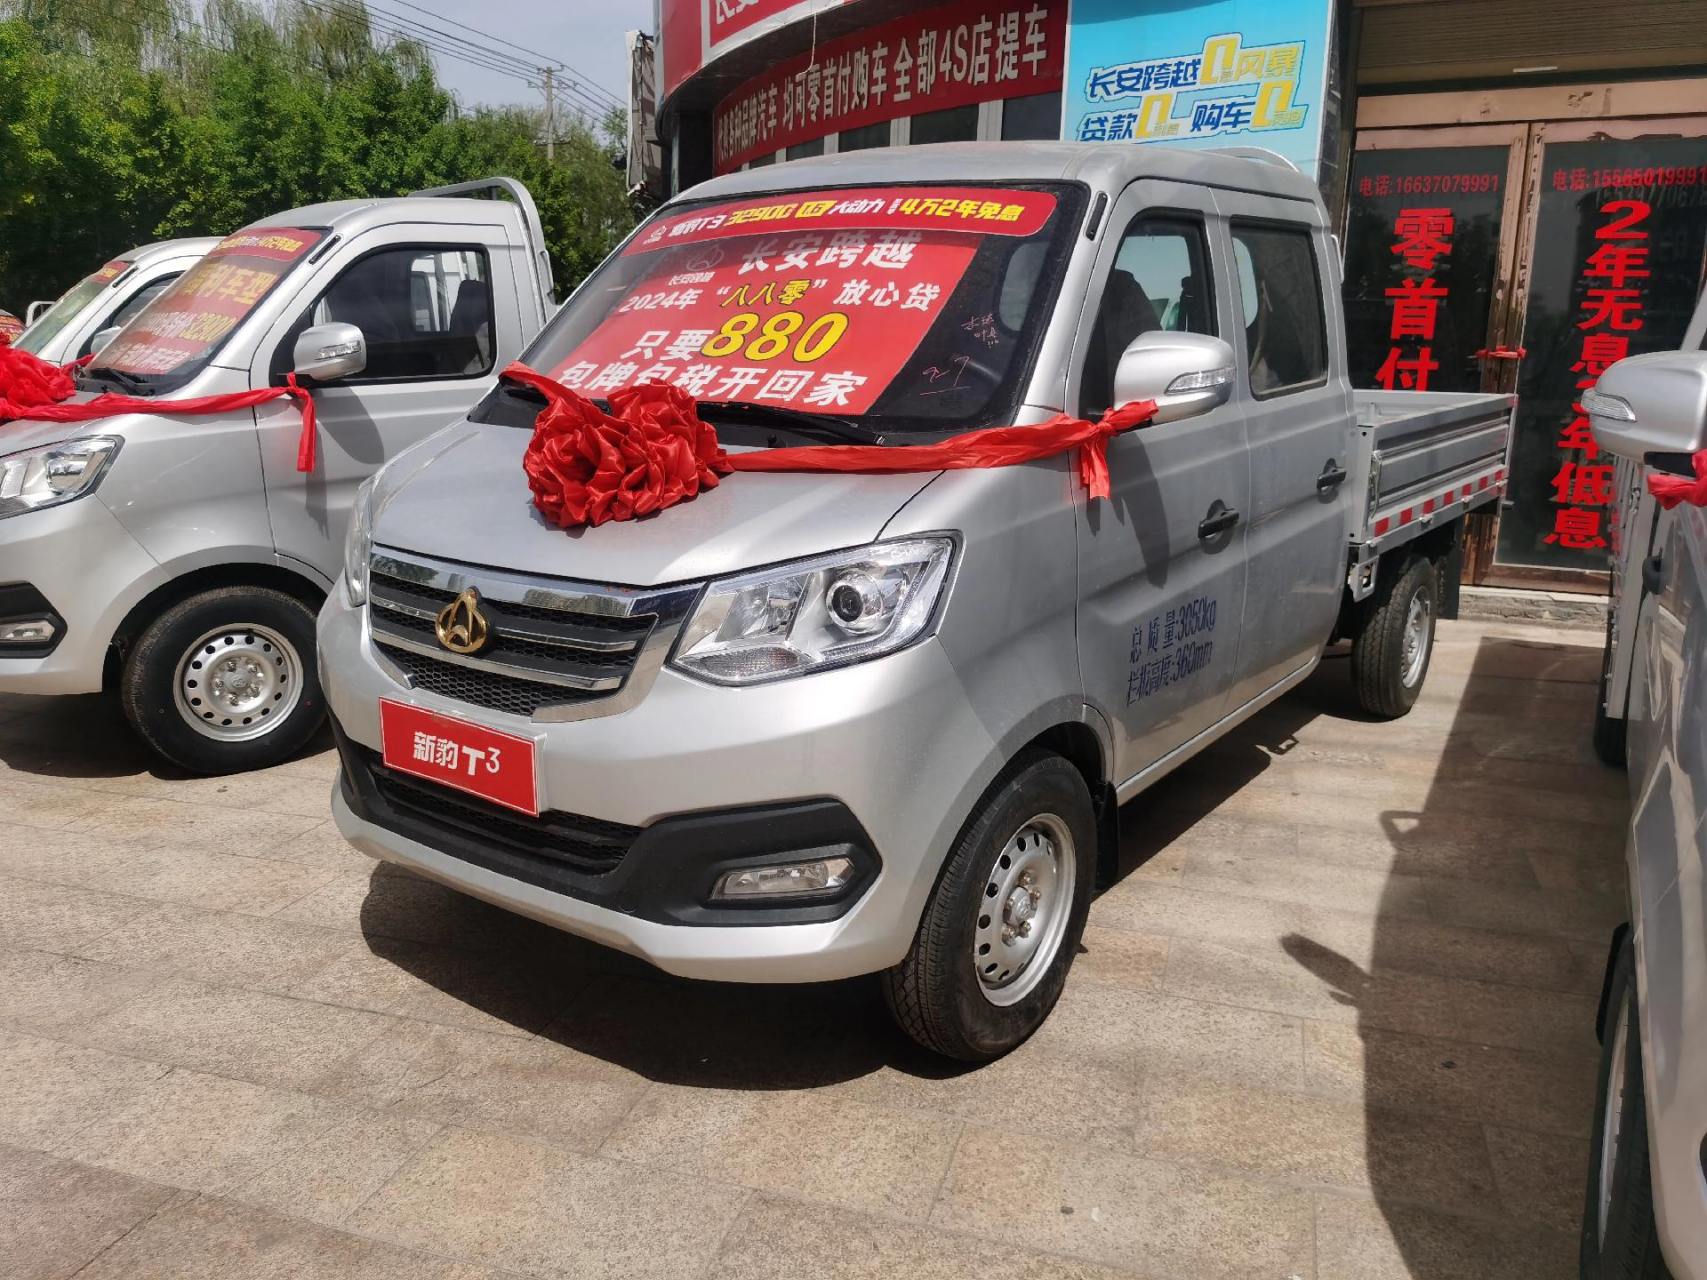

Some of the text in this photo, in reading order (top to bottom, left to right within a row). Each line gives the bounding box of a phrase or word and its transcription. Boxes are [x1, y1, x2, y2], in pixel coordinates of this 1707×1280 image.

[737, 230, 922, 275] 长安跨越
[618, 288, 703, 313] 2024年
[833, 279, 941, 311] 放心贷
